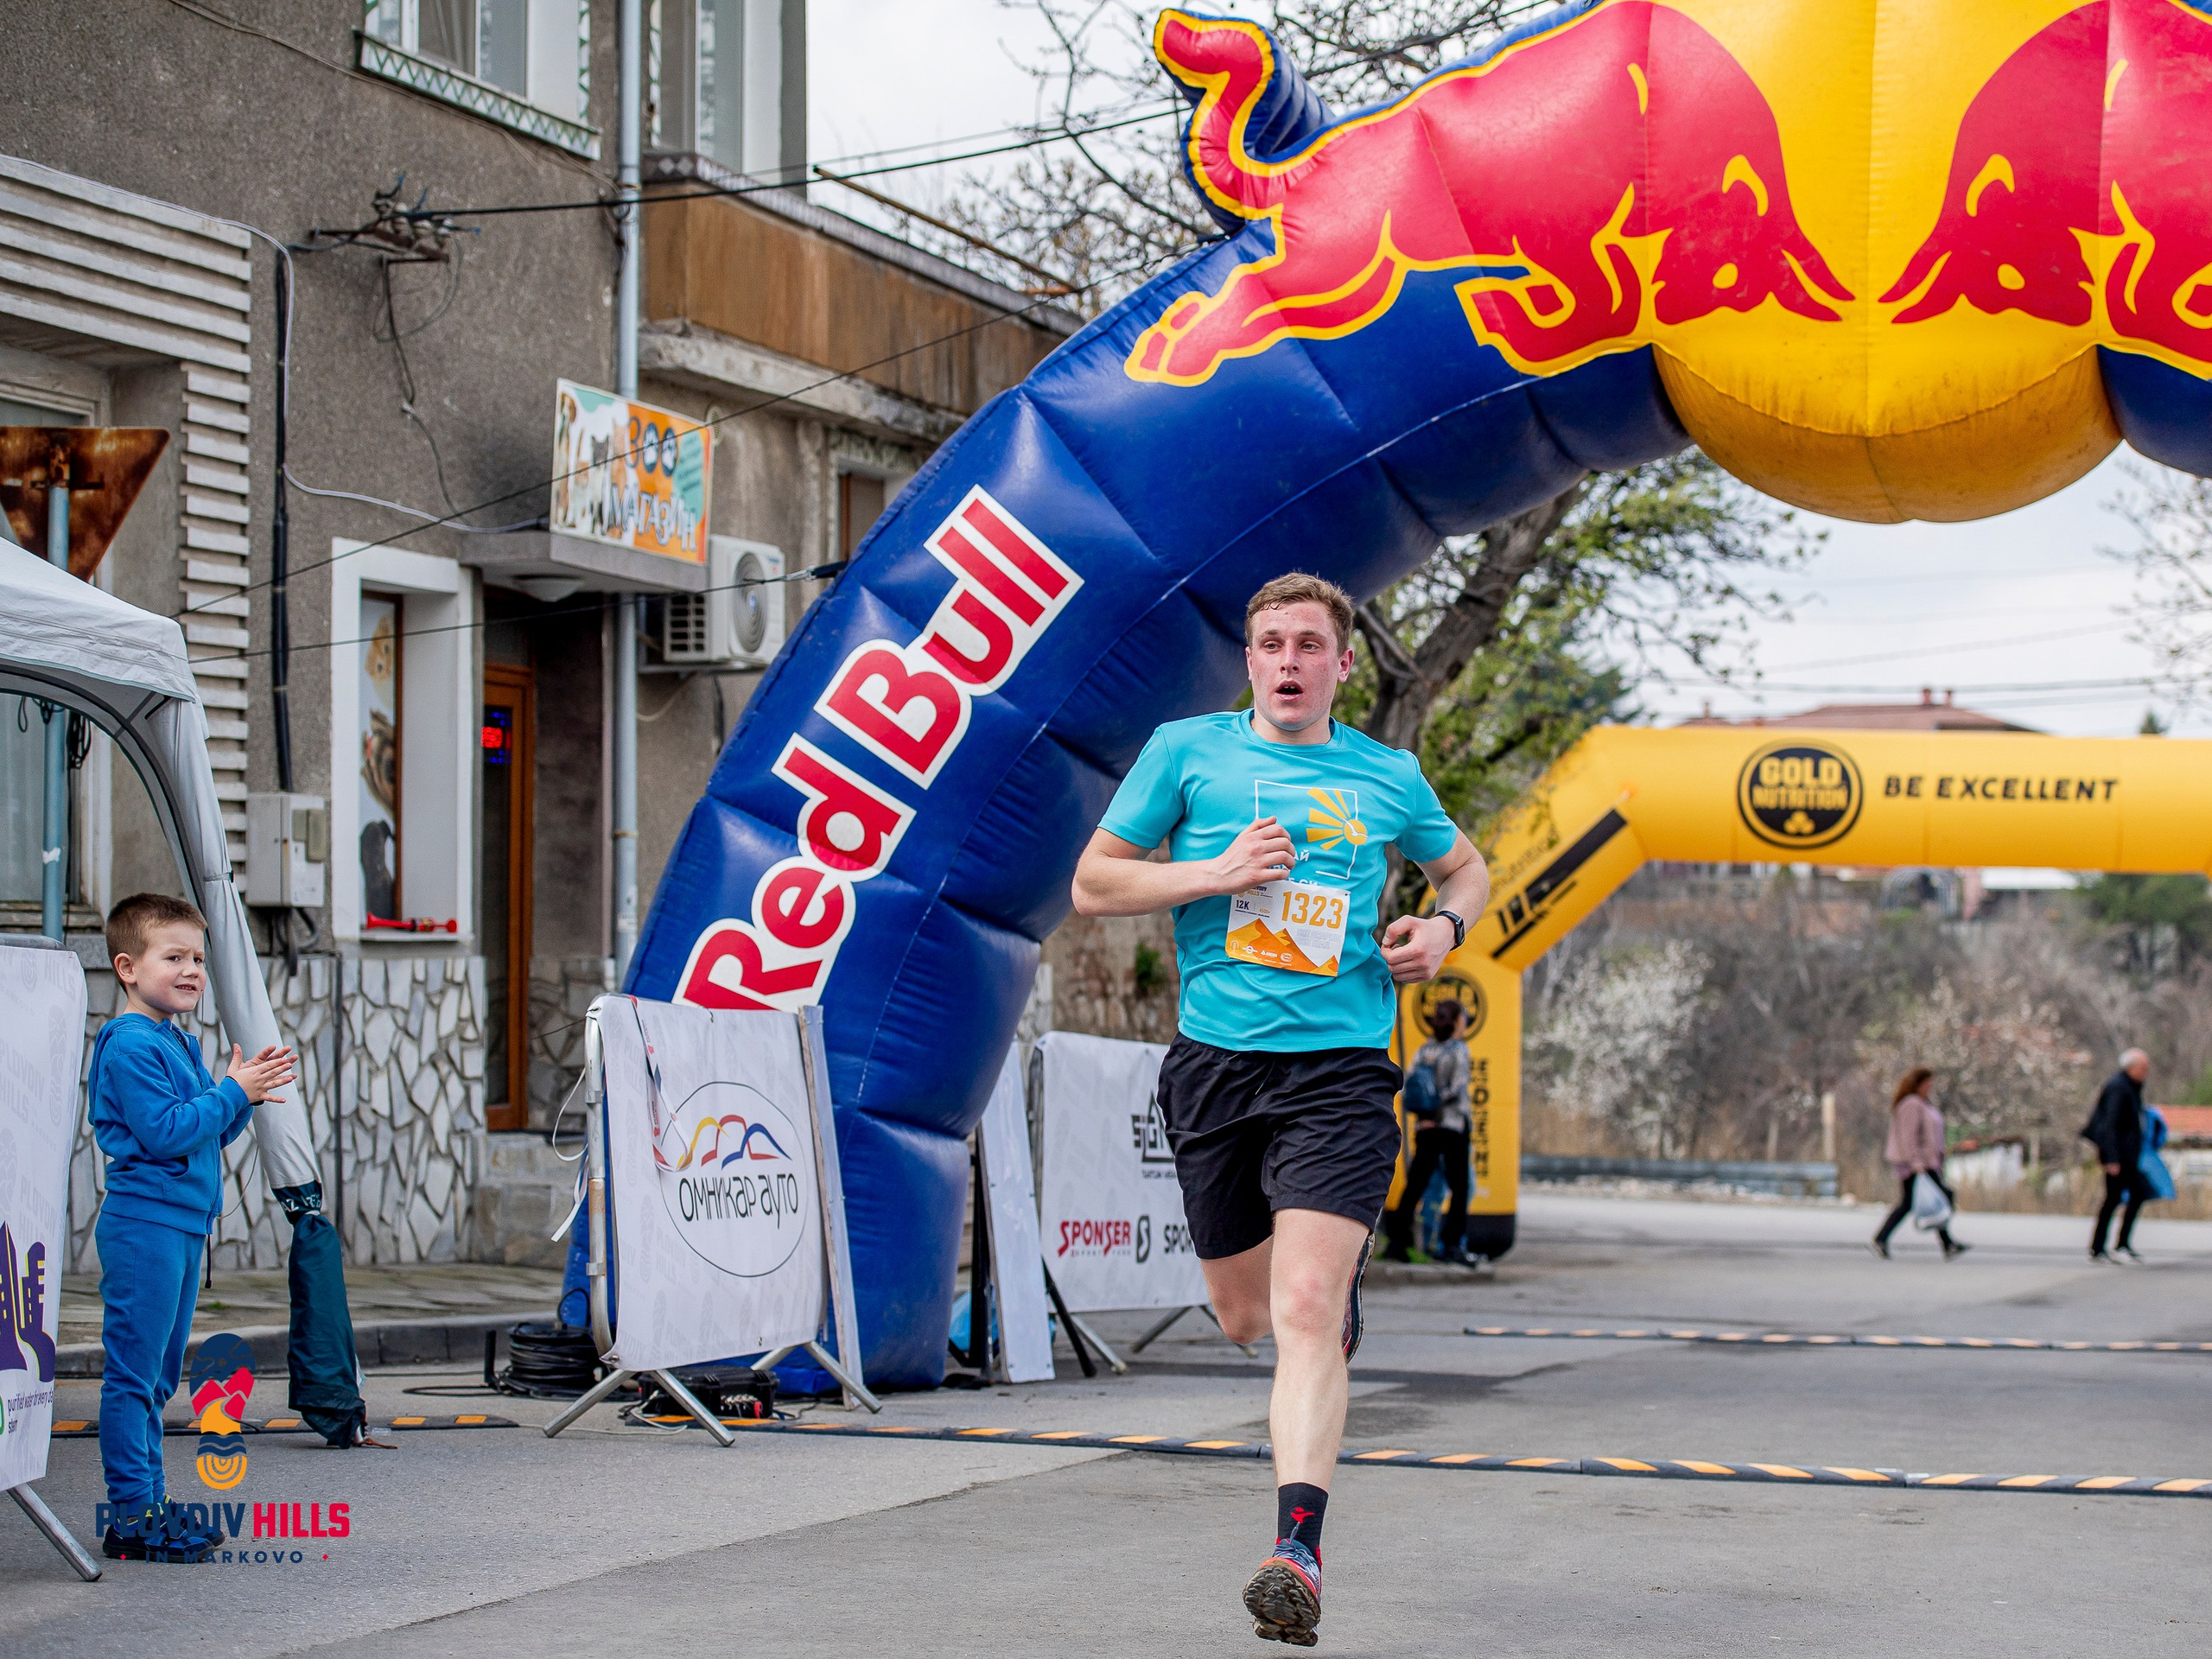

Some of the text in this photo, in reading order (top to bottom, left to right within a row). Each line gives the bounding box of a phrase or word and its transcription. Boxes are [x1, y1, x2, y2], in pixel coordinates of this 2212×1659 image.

[678, 492, 1077, 1011] Red Bull
[1758, 756, 1843, 787] GOLD
[1752, 785, 1849, 810] NUTRITION
[1885, 776, 2118, 800] BE EXCELLENT
[1236, 899, 1249, 911] 12K
[1282, 891, 1344, 930] 1323
[1058, 1220, 1131, 1257] SPONSER
